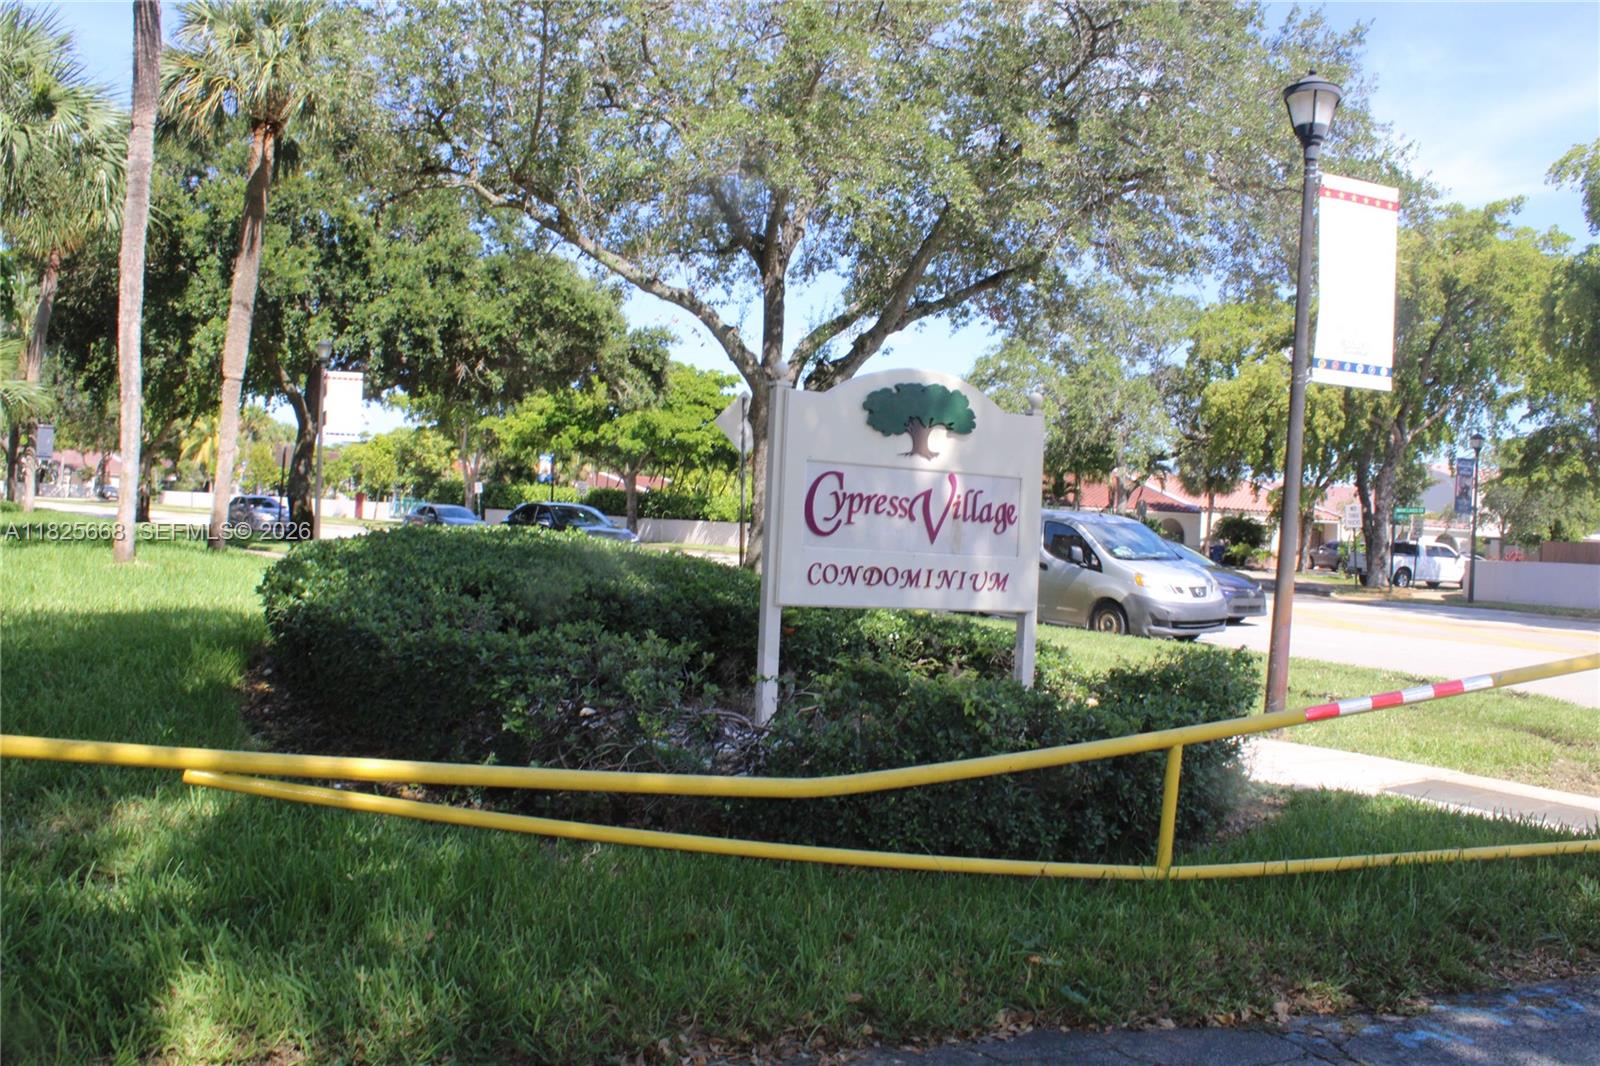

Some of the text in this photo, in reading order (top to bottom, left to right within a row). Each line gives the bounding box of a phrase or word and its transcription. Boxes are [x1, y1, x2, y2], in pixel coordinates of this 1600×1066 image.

[804, 470, 1018, 545] Cypress Village
[807, 562, 1010, 593] CONDOMINIUM
